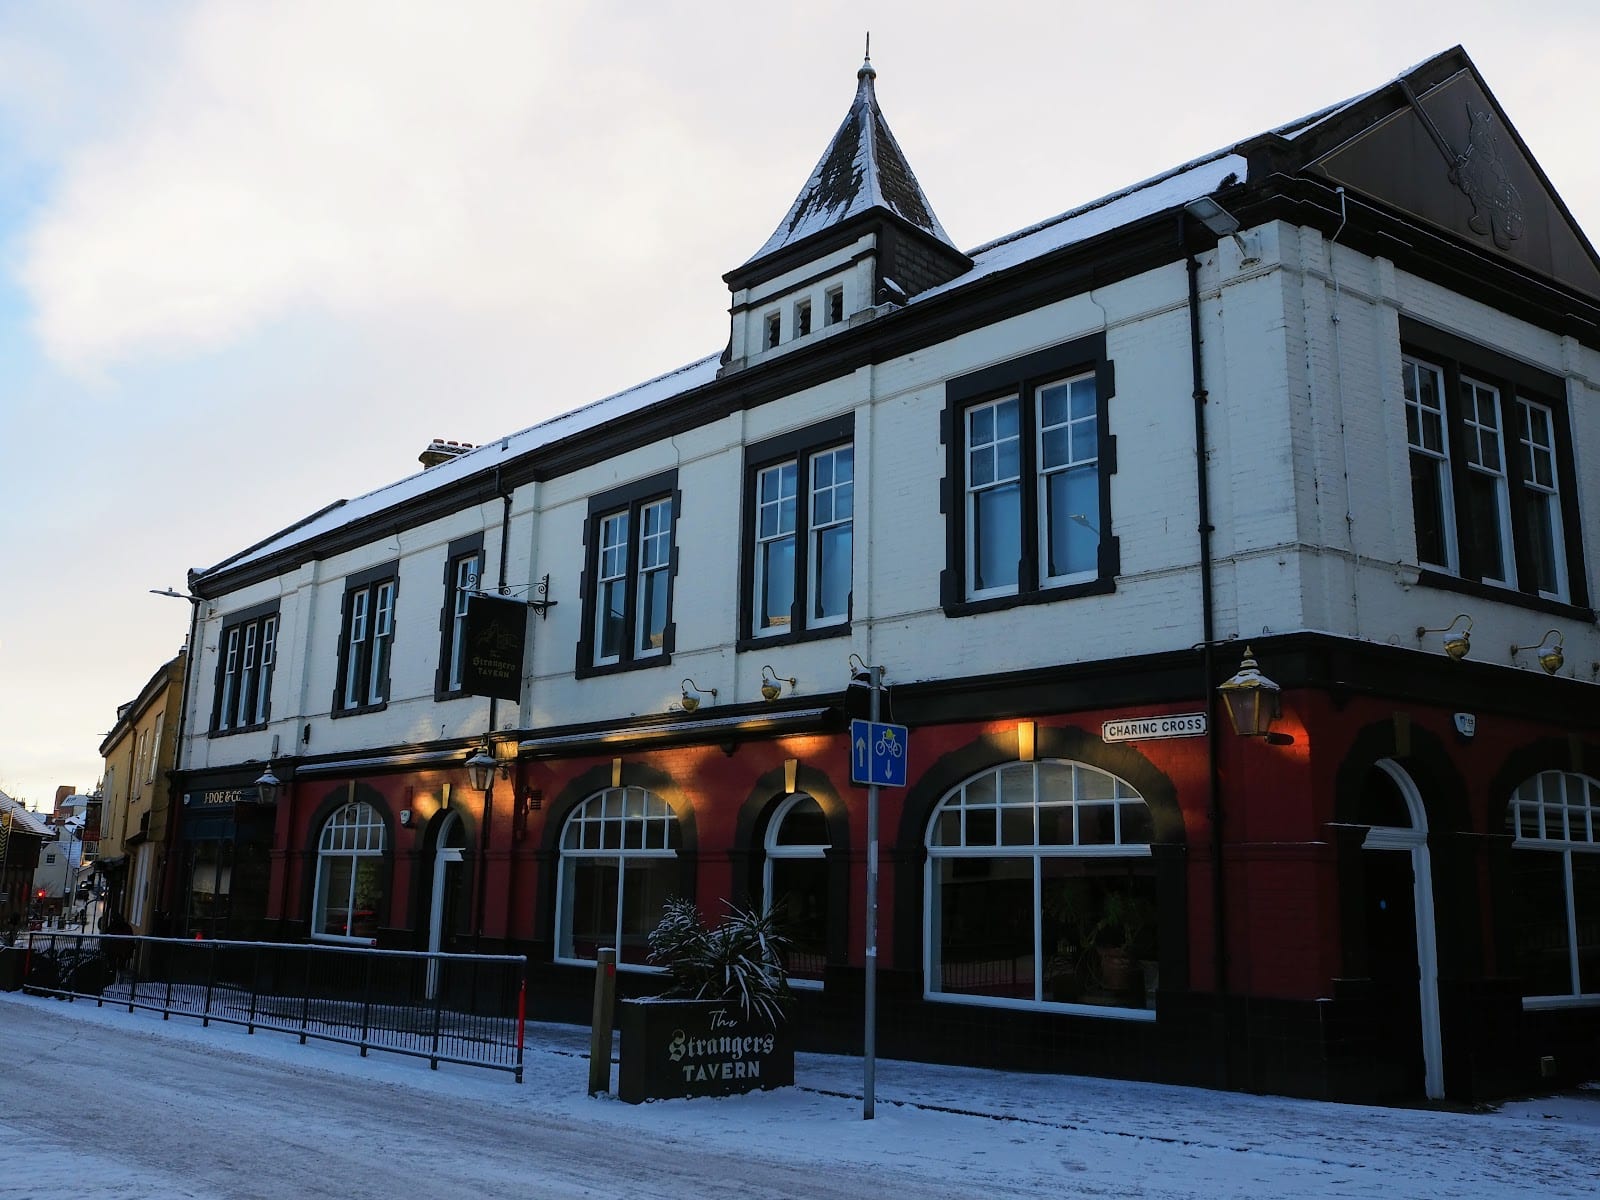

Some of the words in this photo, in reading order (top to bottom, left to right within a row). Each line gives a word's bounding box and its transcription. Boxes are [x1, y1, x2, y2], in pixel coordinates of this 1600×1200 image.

[1109, 722, 1157, 736] CHARING
[1161, 718, 1202, 732] CROSS
[708, 1007, 738, 1031] The
[668, 1028, 775, 1062] Strangers
[682, 1060, 760, 1082] TAVERN
